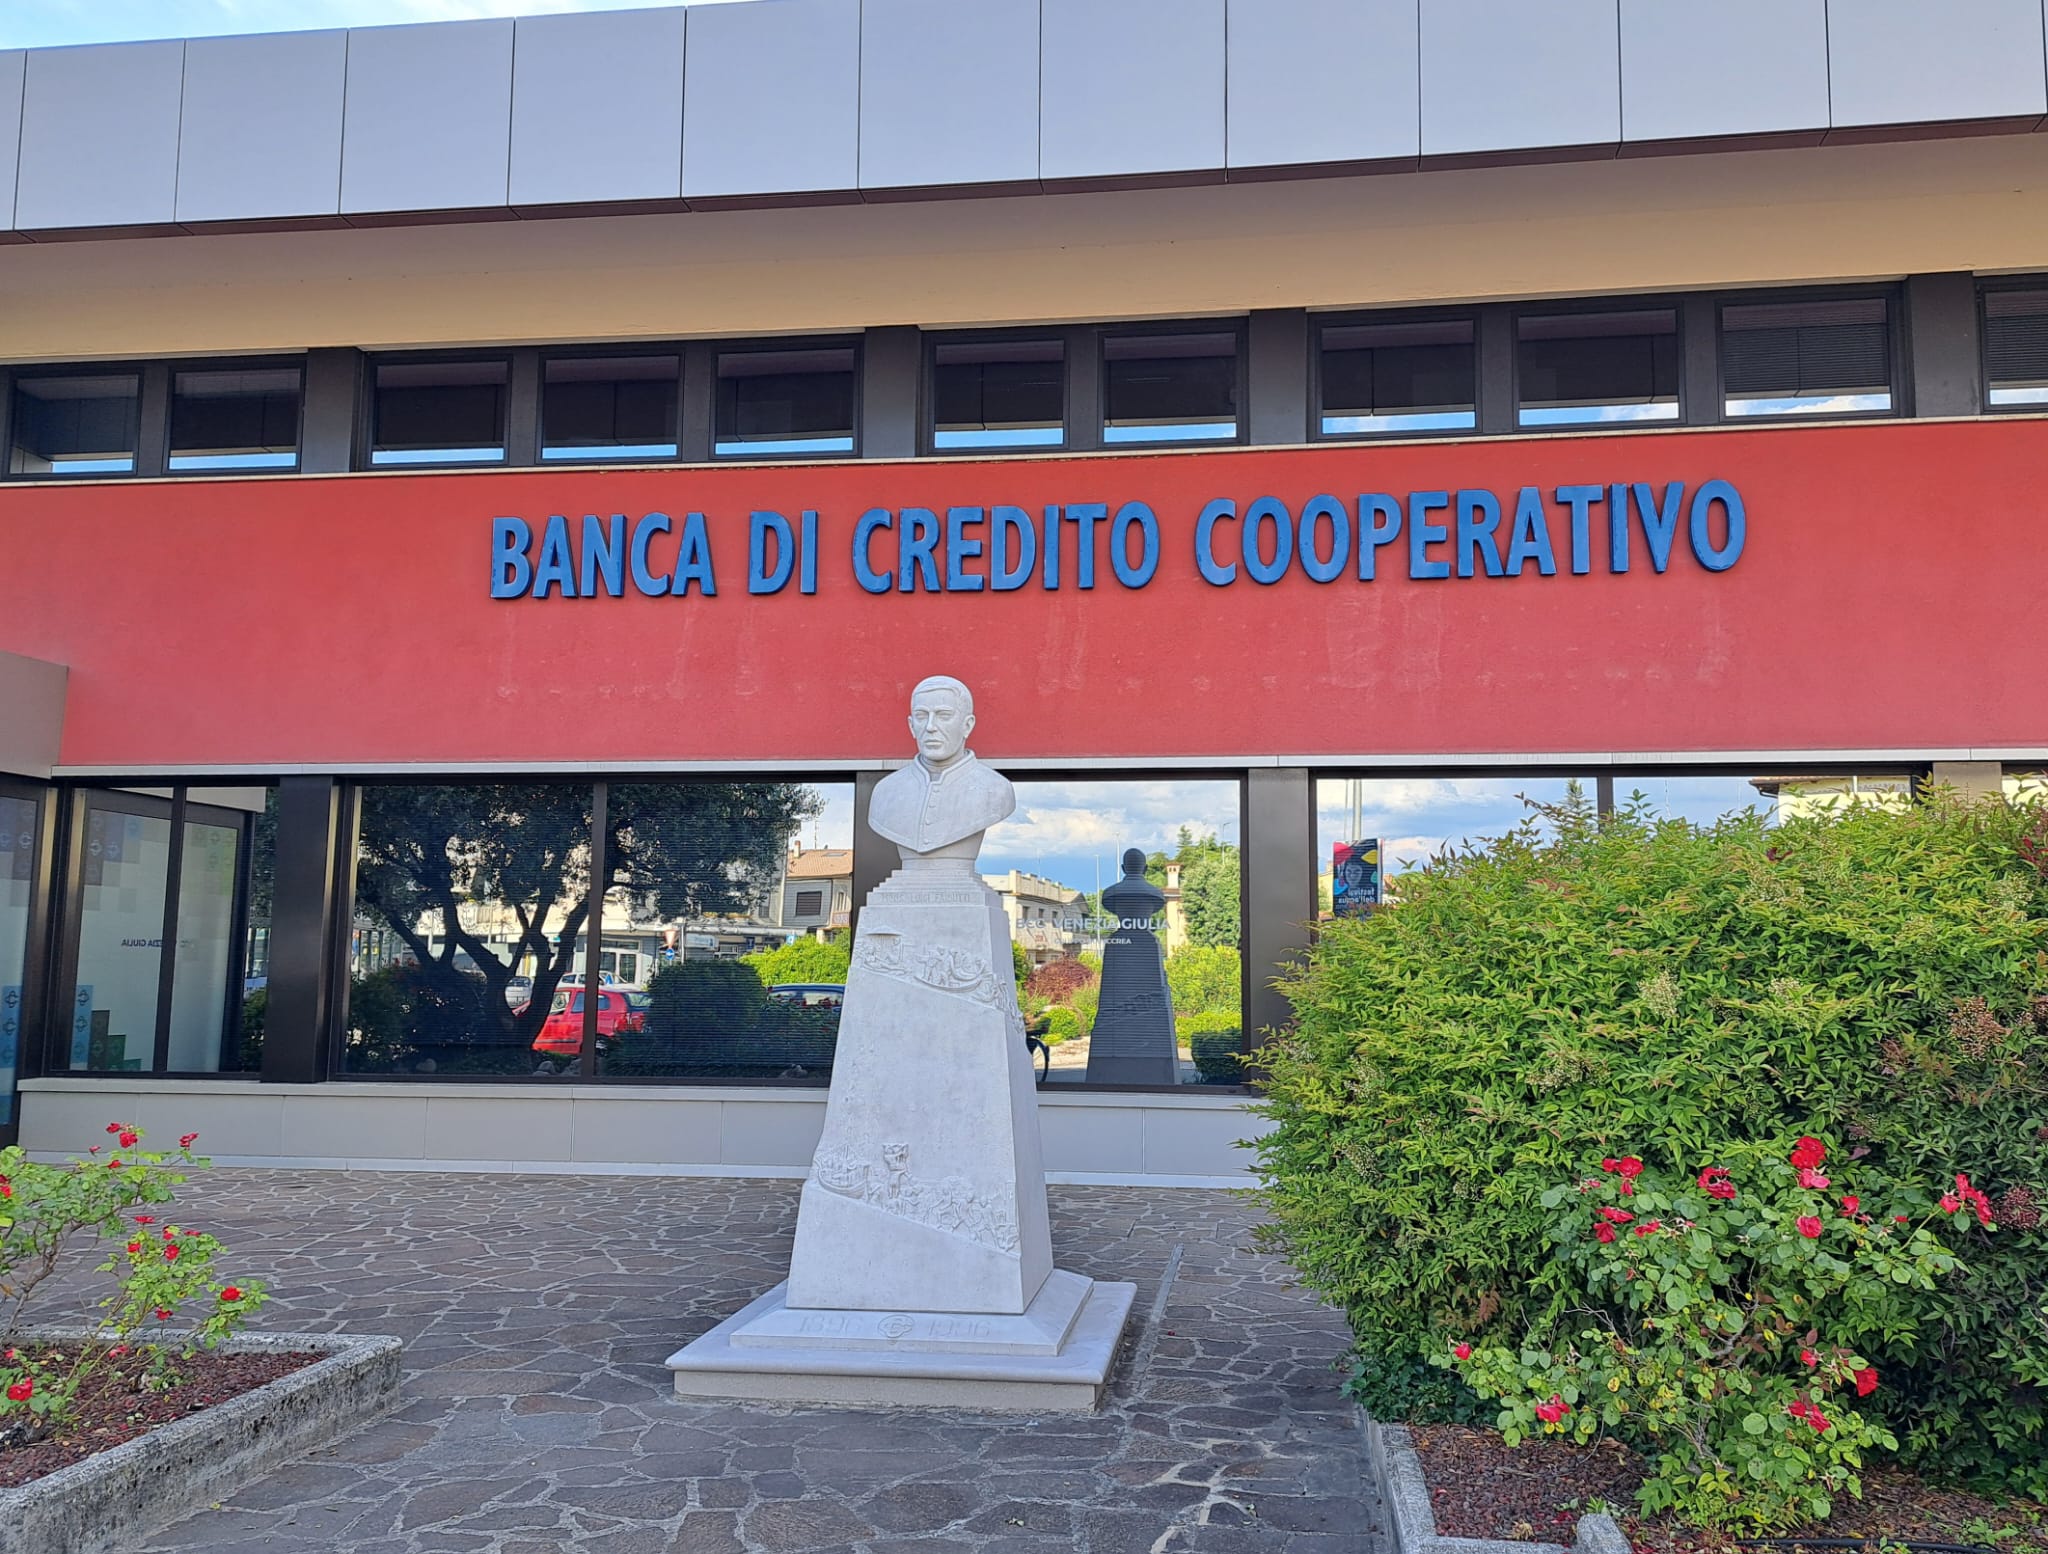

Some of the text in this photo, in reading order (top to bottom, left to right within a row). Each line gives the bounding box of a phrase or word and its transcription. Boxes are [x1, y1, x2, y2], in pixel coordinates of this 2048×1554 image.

[490, 479, 1747, 601] BANCA DI CREDITO COOPERATIVO
[1053, 917, 1120, 930] VENEZIA
[1121, 917, 1171, 930] GIULIA
